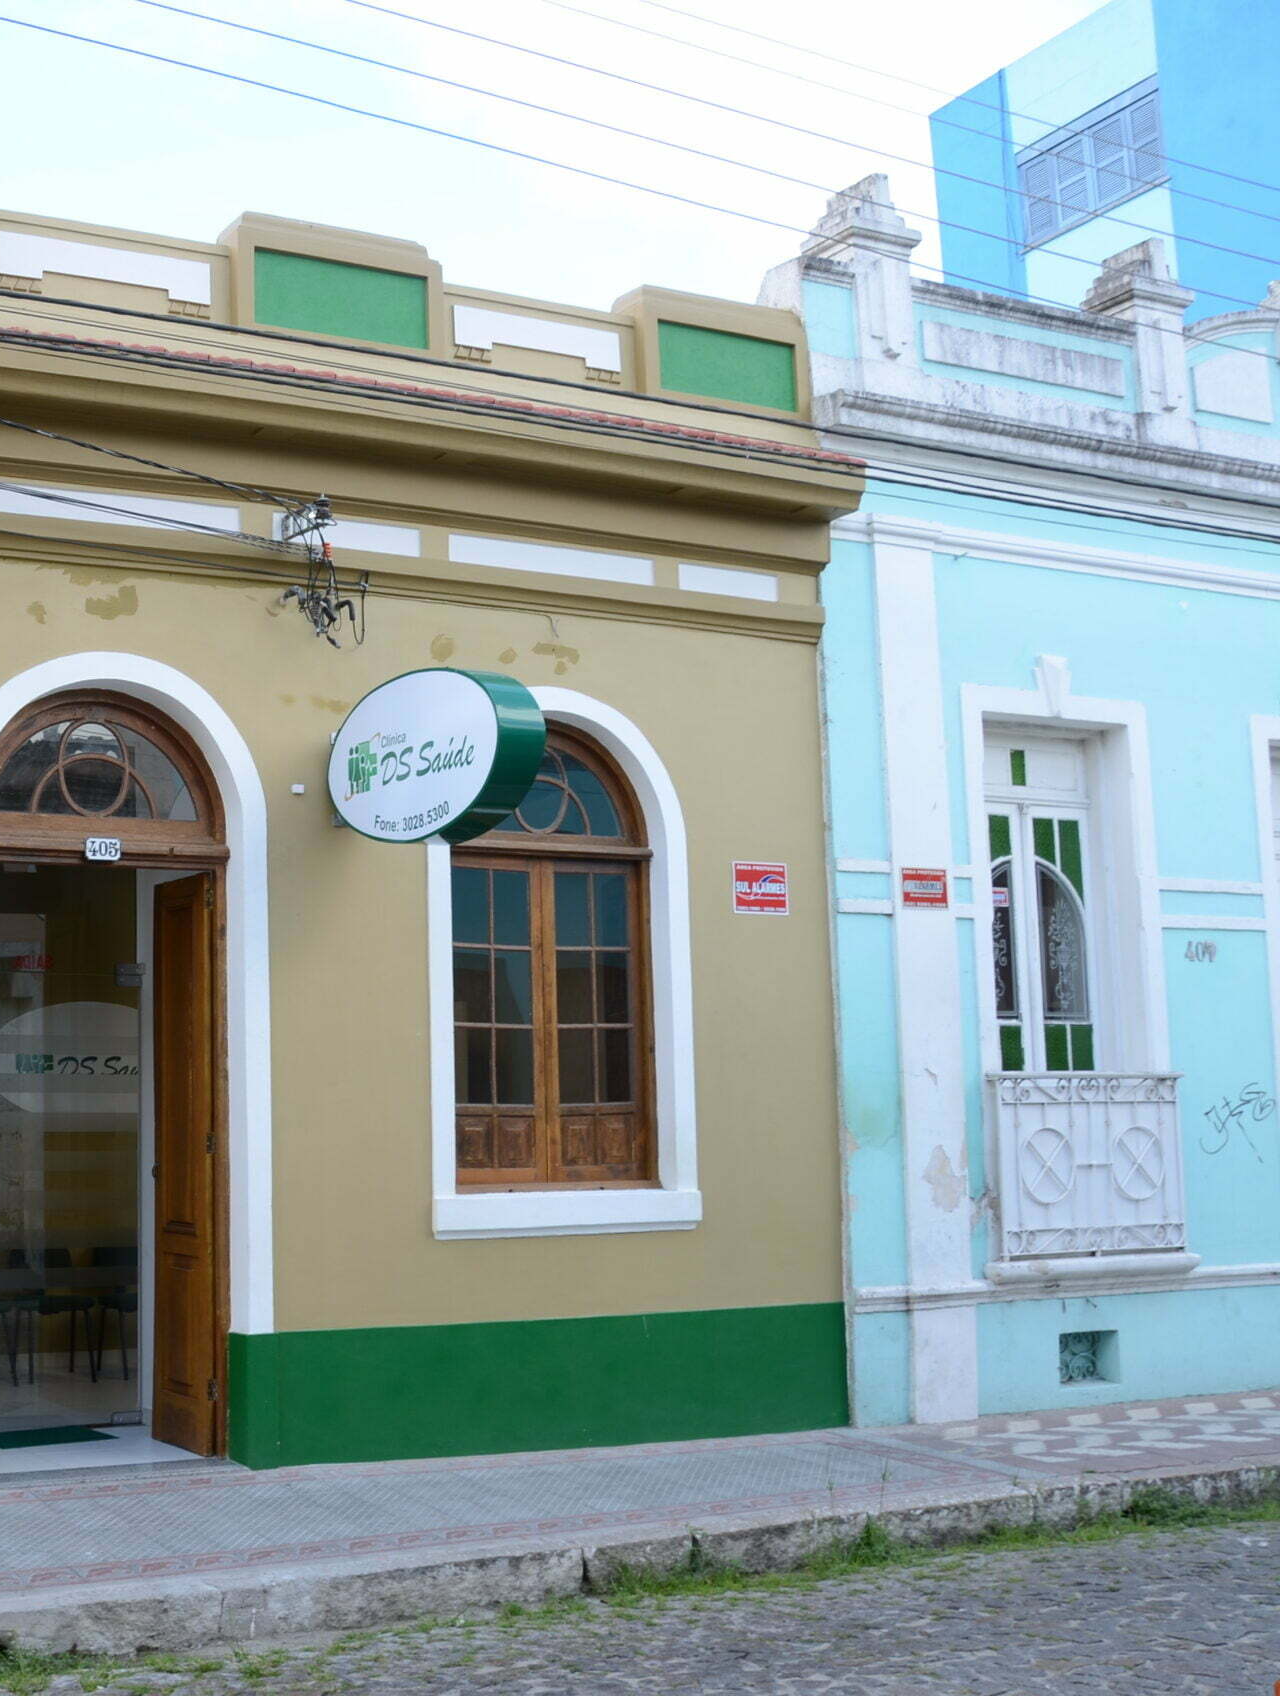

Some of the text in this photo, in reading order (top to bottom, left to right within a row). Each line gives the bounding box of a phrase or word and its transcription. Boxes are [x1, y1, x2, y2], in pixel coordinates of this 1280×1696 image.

[380, 735, 474, 786] DS Saúde
[374, 801, 450, 833] Fone: 3028.5300
[87, 840, 118, 858] 405
